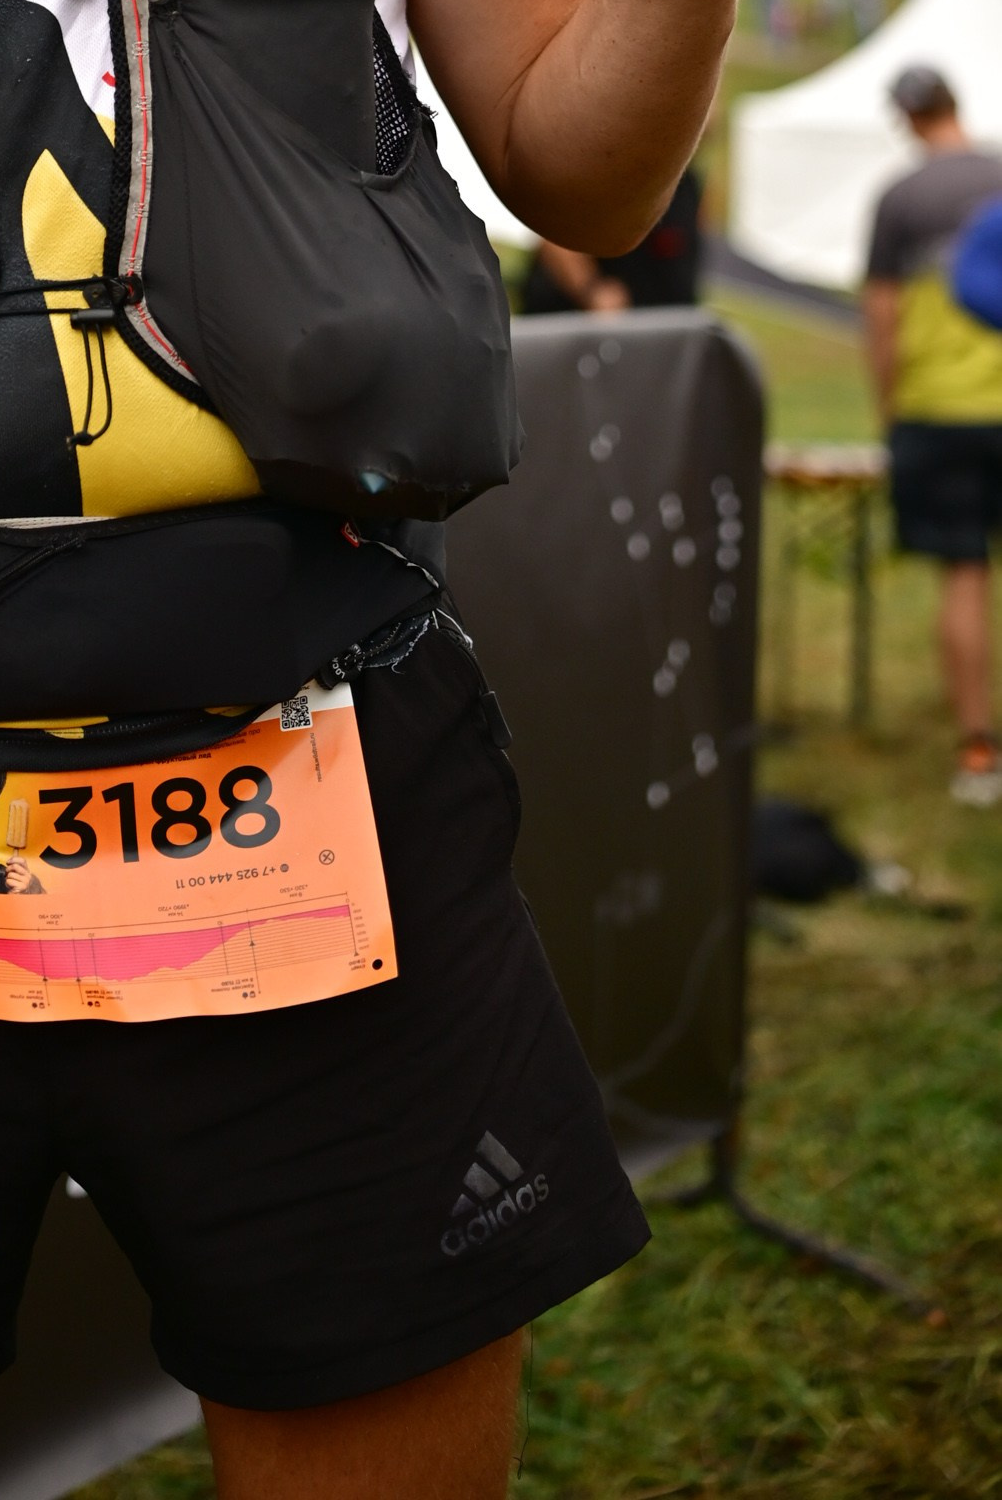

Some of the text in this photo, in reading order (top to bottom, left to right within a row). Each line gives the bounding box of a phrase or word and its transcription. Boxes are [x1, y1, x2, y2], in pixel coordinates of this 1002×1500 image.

[38, 765, 282, 869] 3188
[175, 866, 276, 889] +7 925 444 00 11
[440, 1172, 550, 1257] adidas
